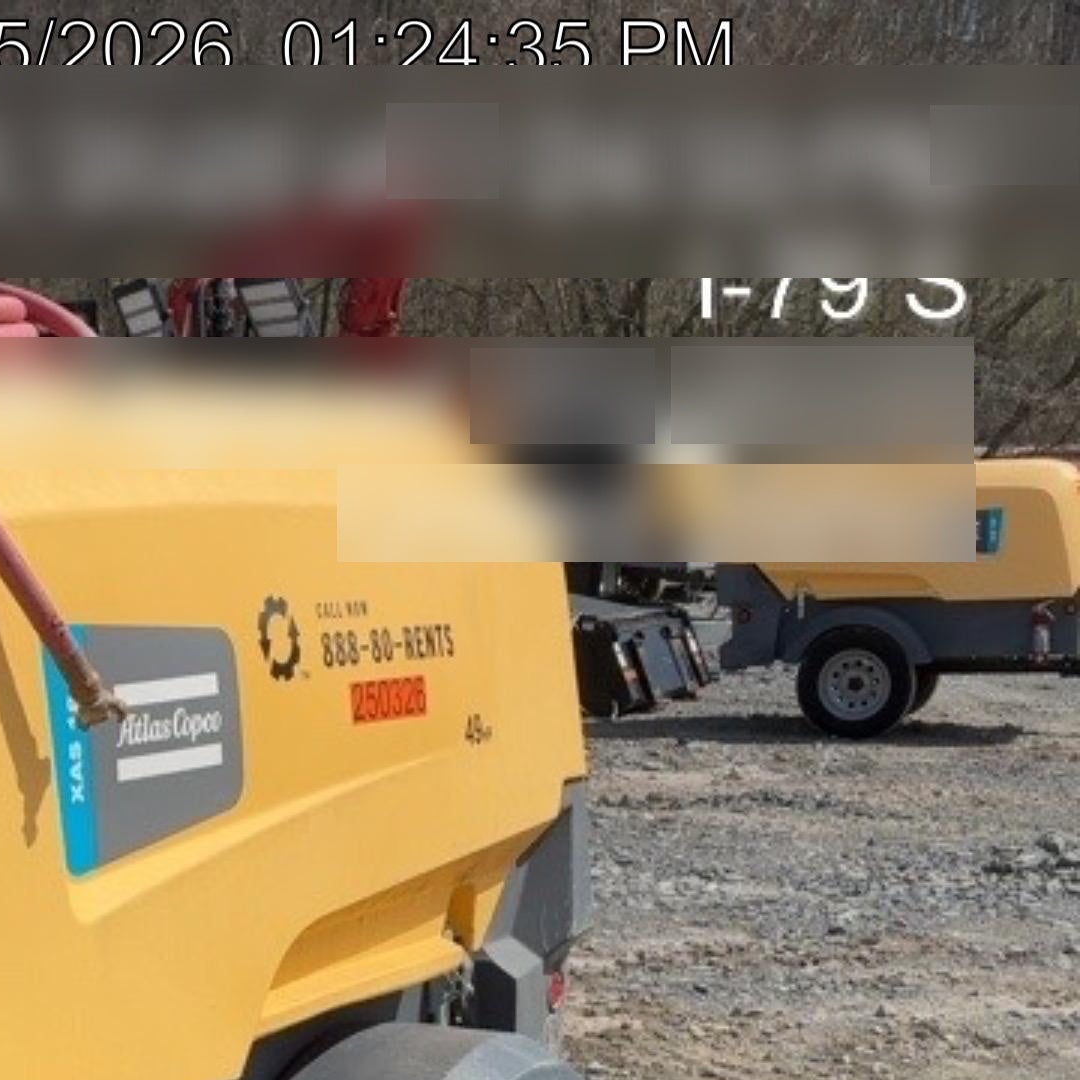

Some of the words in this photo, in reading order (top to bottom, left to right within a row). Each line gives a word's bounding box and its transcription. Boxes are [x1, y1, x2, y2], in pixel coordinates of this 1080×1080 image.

[321, 623, 455, 668] 888-80-RENTS
[351, 676, 427, 722] 250326
[116, 713, 172, 748] Atlas
[173, 707, 223, 743] Copco
[68, 740, 85, 804] XAS
